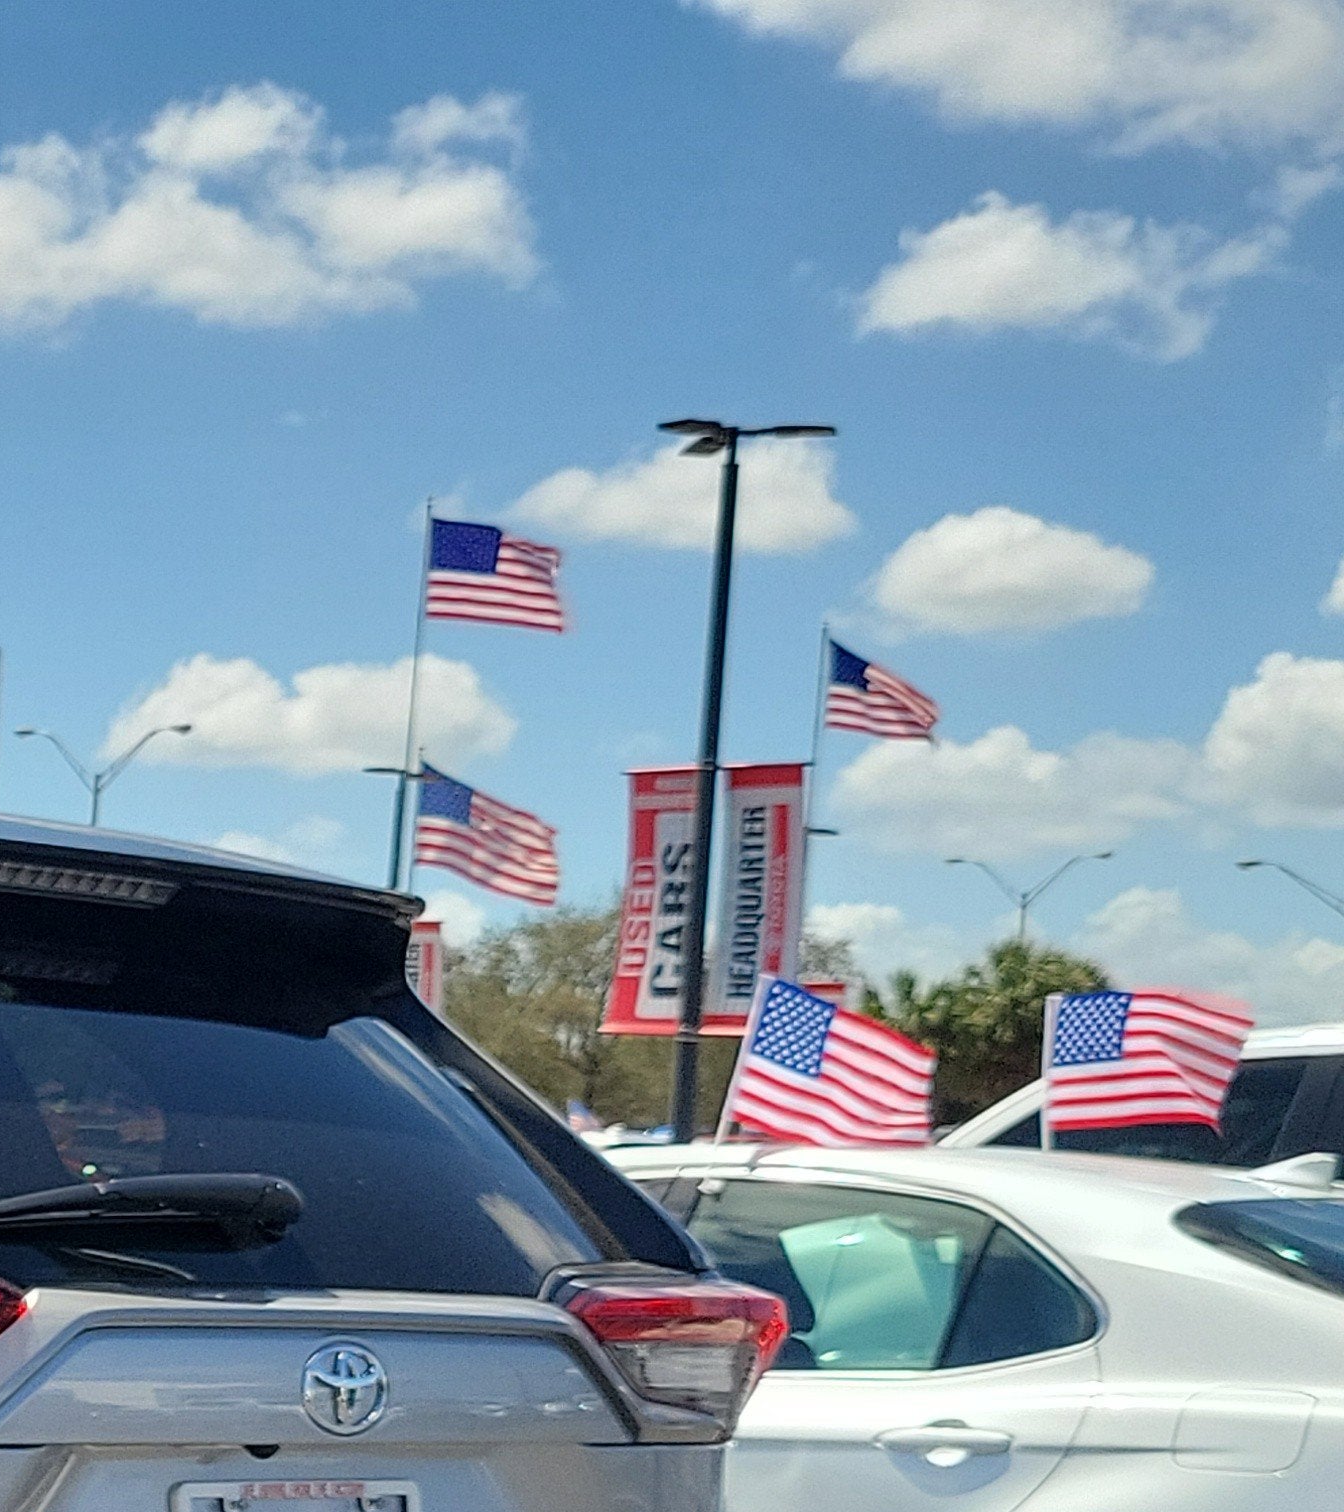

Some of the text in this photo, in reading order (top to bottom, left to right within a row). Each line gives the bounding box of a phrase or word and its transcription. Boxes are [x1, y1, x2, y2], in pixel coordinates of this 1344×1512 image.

[618, 863, 656, 970] USED
[651, 842, 691, 997] CARS
[725, 806, 767, 998] HEADQUARTER
